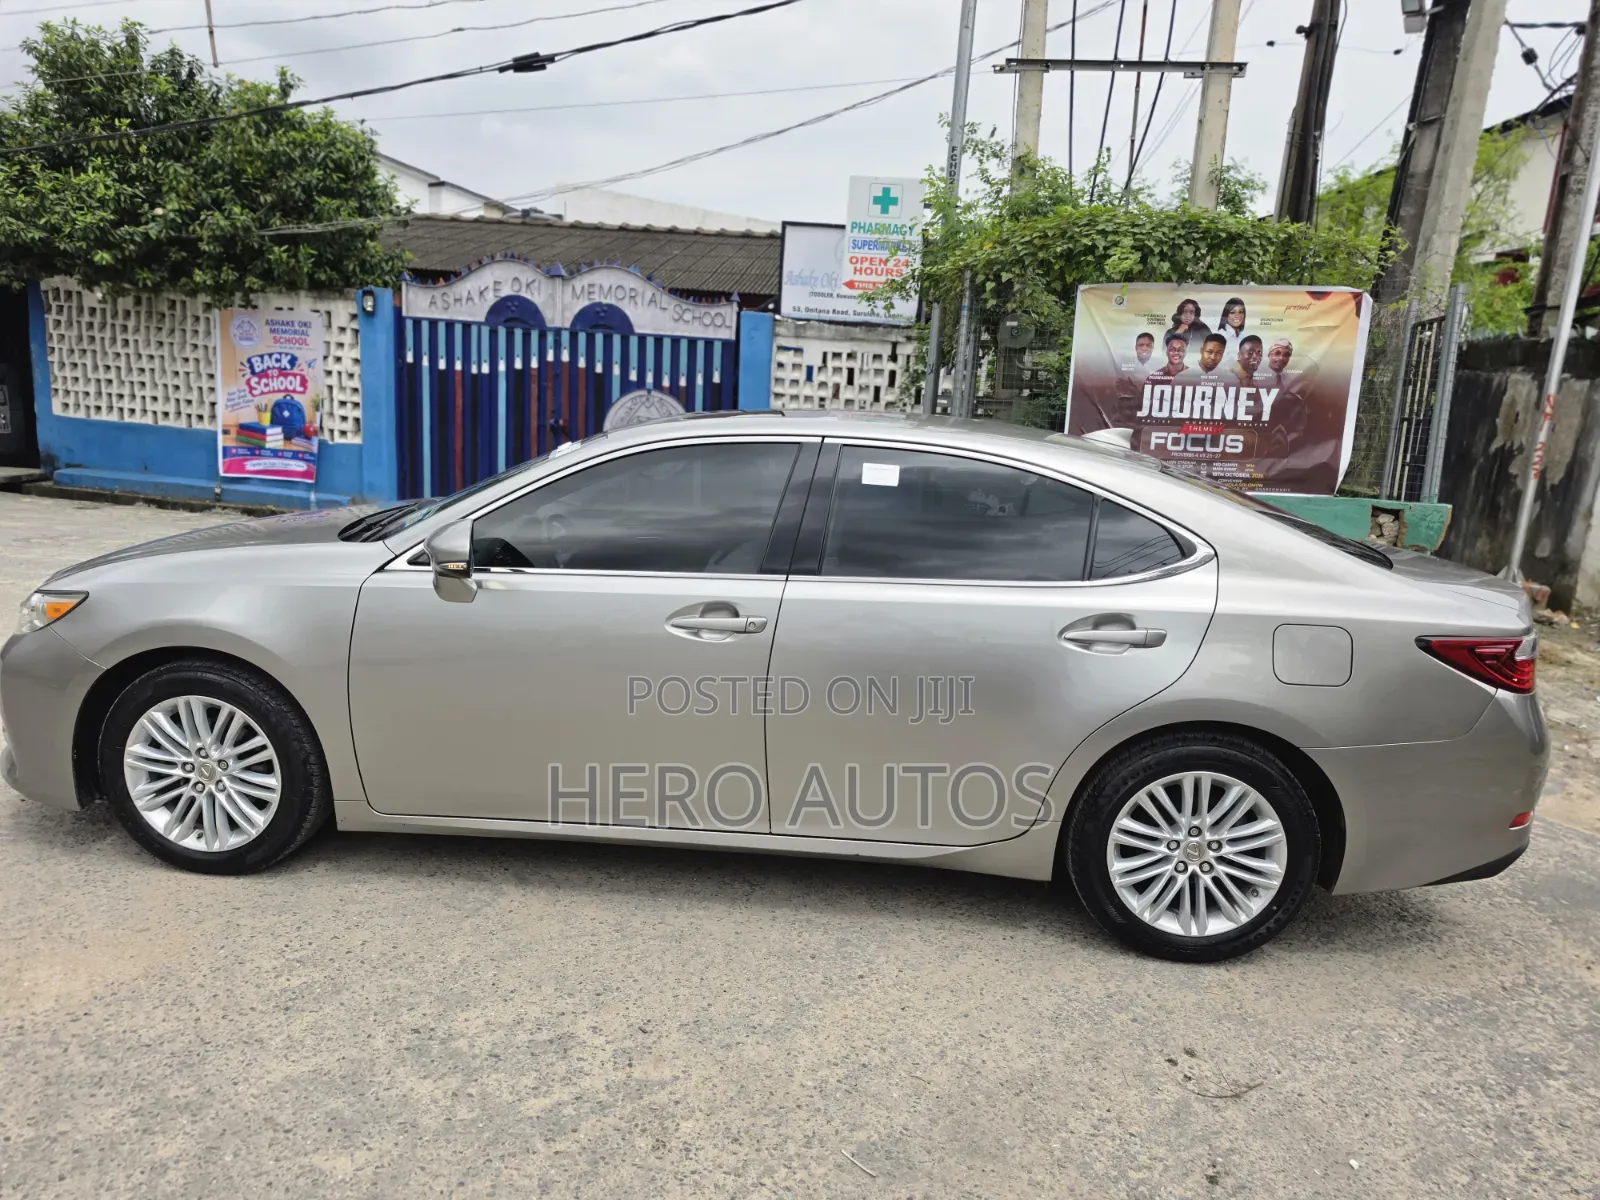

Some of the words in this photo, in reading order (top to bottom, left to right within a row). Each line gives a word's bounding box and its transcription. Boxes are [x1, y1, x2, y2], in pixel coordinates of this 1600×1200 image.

[849, 255, 888, 266] OPEN
[893, 258, 909, 268] 24
[853, 266, 903, 277] HOURS
[428, 279, 504, 310] ASHAKE
[510, 276, 541, 297] OKI
[571, 283, 669, 311] MEMORIAL
[672, 303, 733, 330] SCHOOL
[832, 308, 851, 316] Road,
[265, 318, 296, 328] ASHAKE
[297, 320, 312, 329] OKI
[269, 327, 310, 337] MEMORIAL
[272, 336, 310, 346] SCHOOL
[250, 353, 292, 373] BACK
[250, 375, 304, 396] SCHOOL
[1136, 384, 1280, 421] JOURNEY
[1150, 432, 1244, 453] FOCUS
